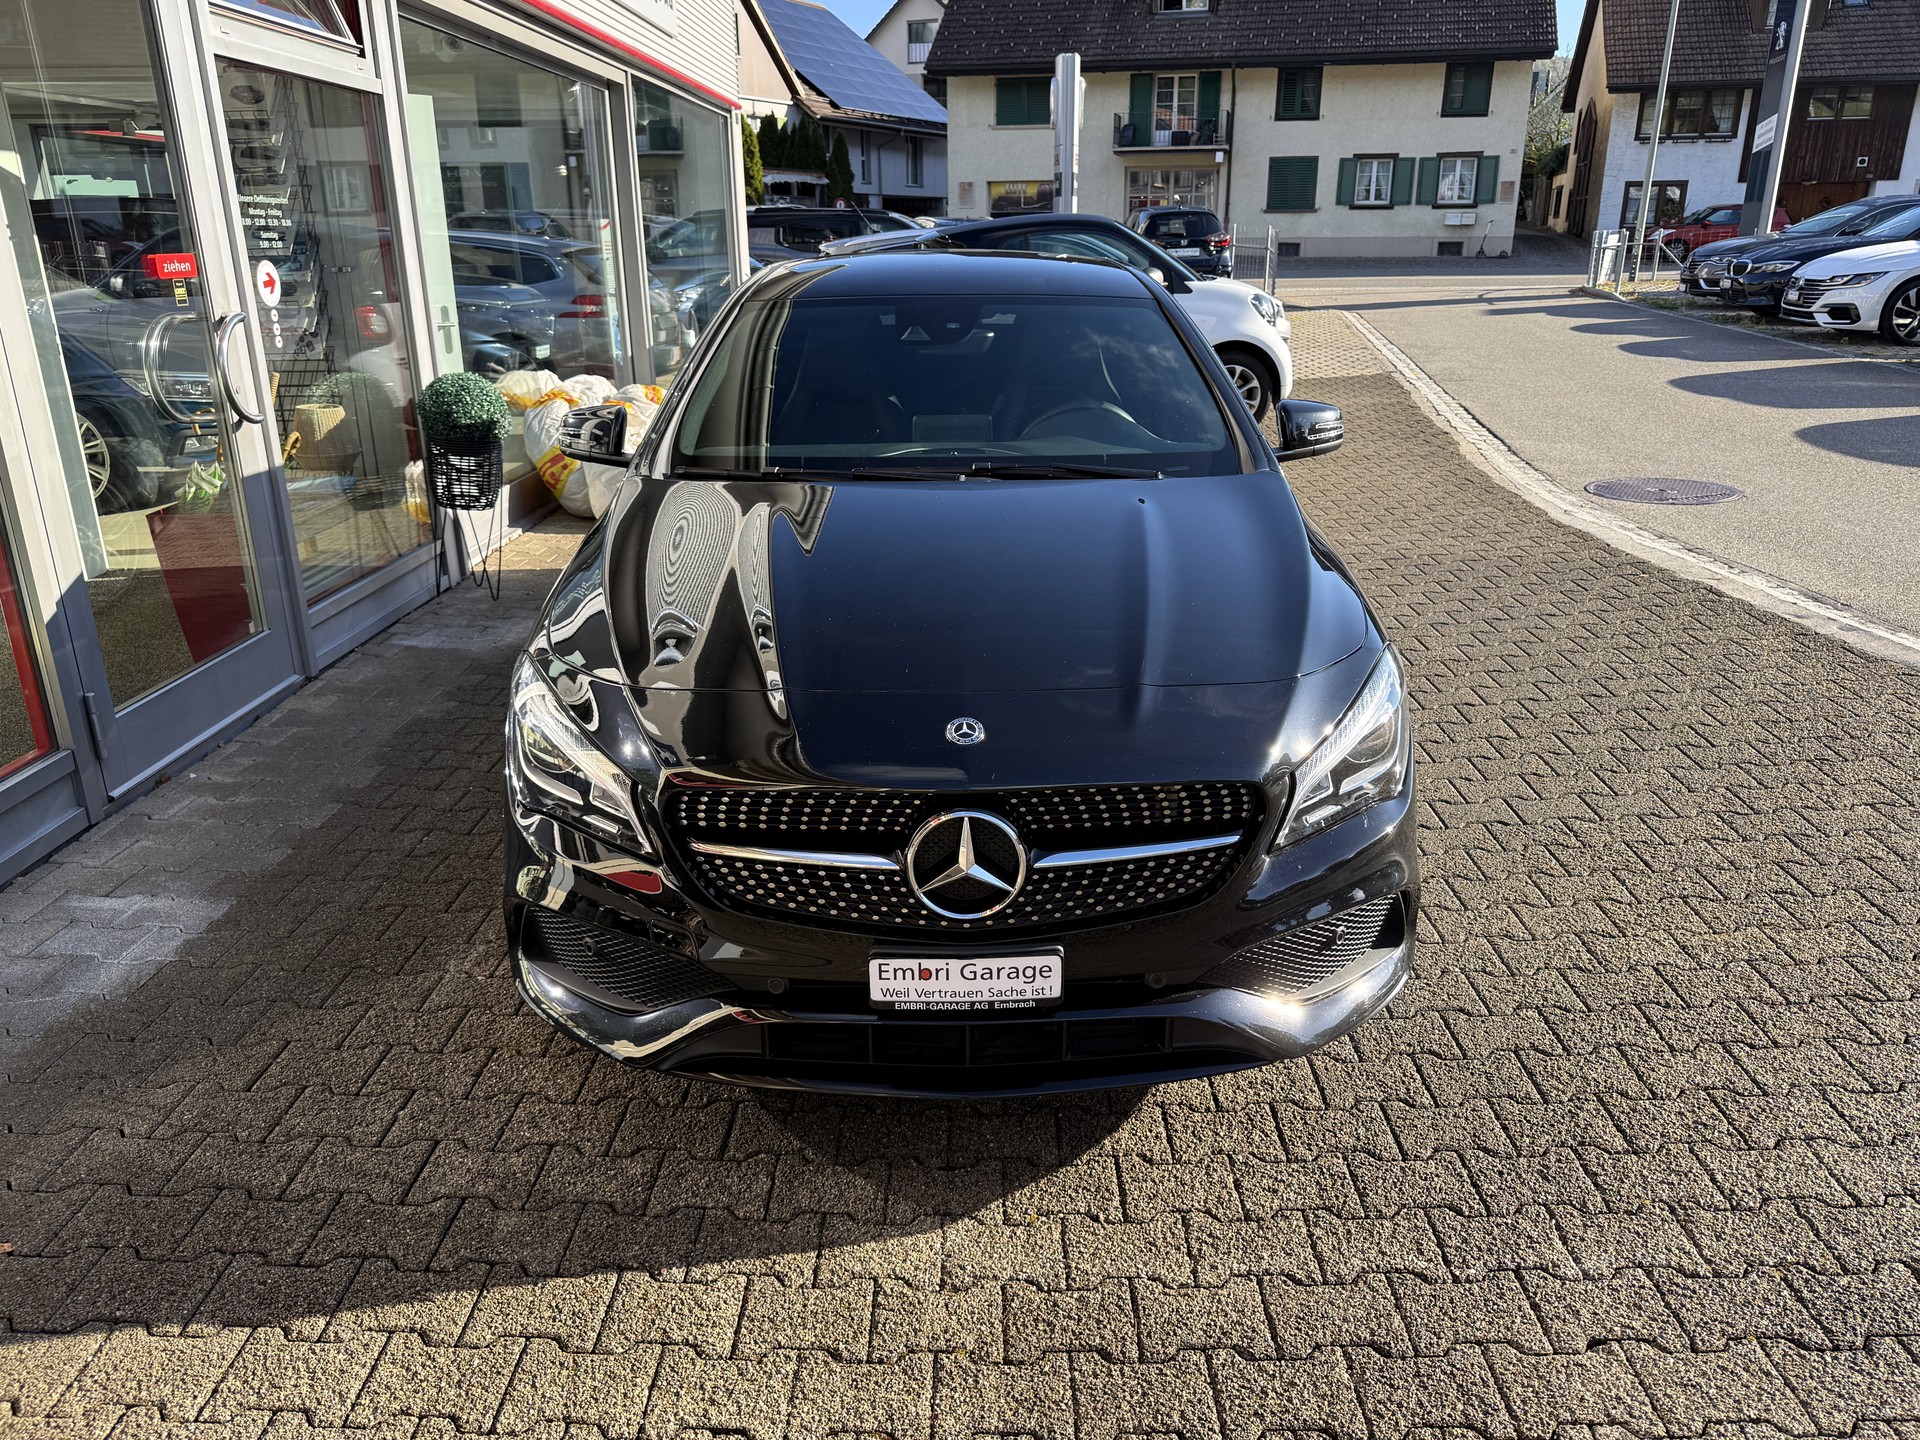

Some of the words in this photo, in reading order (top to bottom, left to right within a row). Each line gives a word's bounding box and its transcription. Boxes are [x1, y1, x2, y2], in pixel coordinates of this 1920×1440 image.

[248, 208, 266, 217] Montag
[268, 208, 282, 218] Freitag
[254, 218, 266, 226] 12.00
[281, 219, 292, 227] 18.00
[260, 231, 278, 240] Samstag
[259, 241, 270, 249] 9.00
[272, 241, 283, 249] 12.00
[163, 260, 191, 272] ziehen
[878, 963, 950, 981] Embri
[960, 963, 1053, 984] Garage
[880, 988, 910, 998] Weil
[914, 988, 984, 999] Vertrauen
[988, 987, 1027, 998] Sache
[1031, 987, 1046, 996] ist
[894, 1002, 971, 1010] EMBRI-GARAGE
[973, 1001, 989, 1010] AG
[994, 1000, 1036, 1010] Embrach
